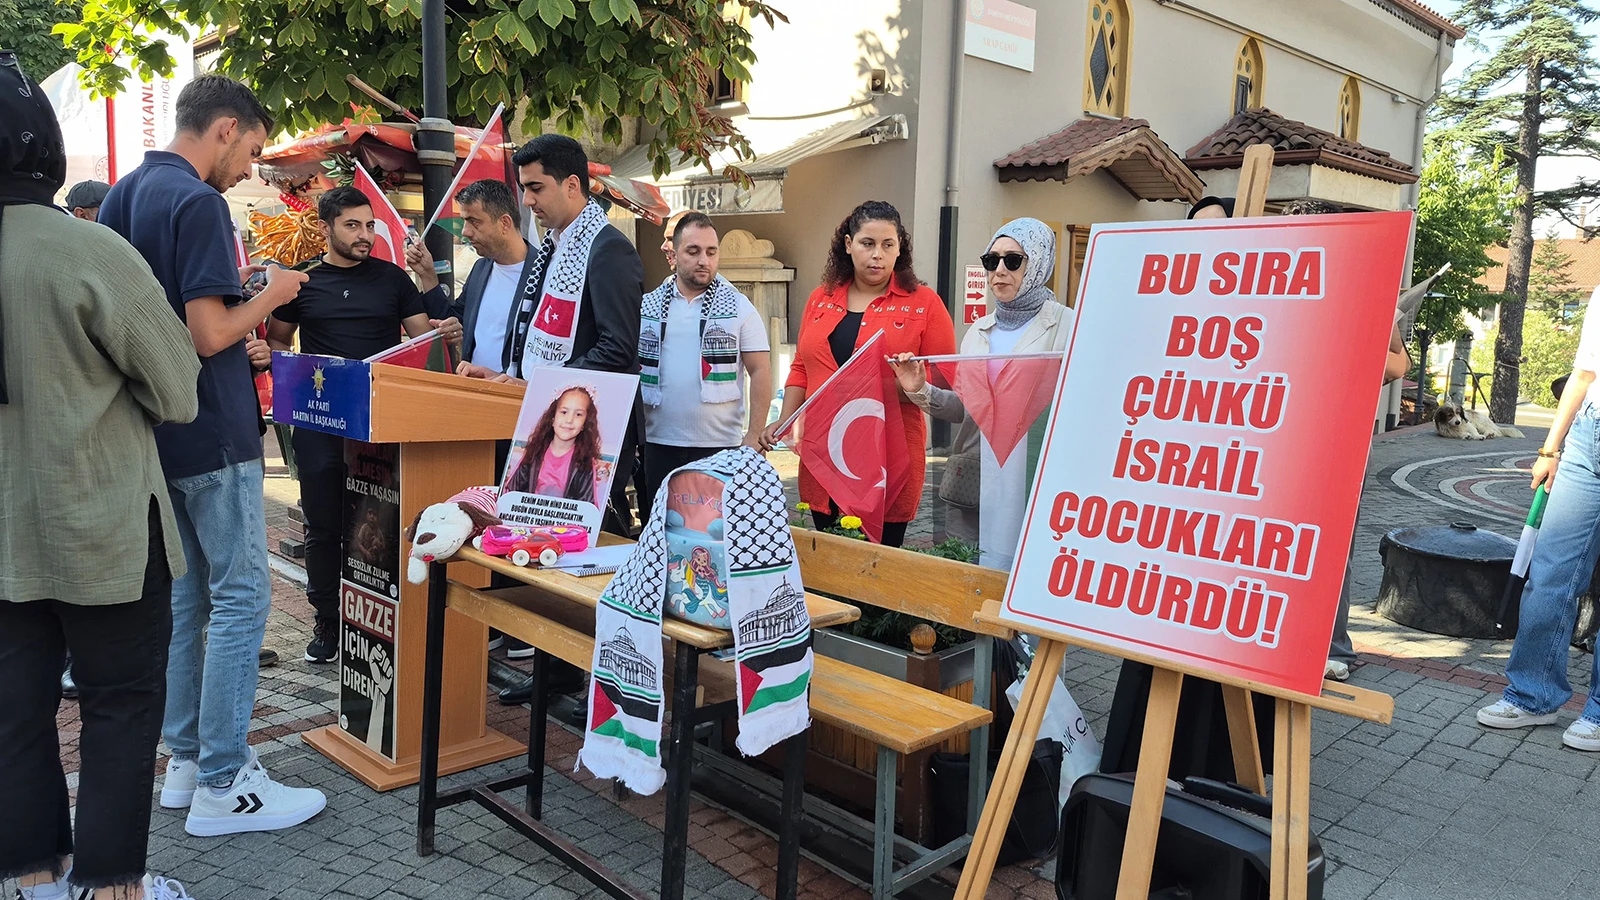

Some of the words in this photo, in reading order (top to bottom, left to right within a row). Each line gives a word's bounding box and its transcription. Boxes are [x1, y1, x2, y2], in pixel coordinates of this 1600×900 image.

[142, 83, 156, 148] BAKANL
[1137, 253, 1202, 295] BU
[1208, 251, 1321, 296] SIRA
[1165, 315, 1263, 370] BOŞ
[307, 399, 315, 409] AK
[315, 401, 330, 412] PARTİ
[1122, 370, 1286, 430] ÇÜNKÜ
[292, 410, 310, 422] BARTIN
[315, 414, 346, 430] BAŞKANLIĞI
[1112, 429, 1261, 497] İSRAİL
[346, 477, 368, 495] GAZZE
[369, 483, 400, 505] YAŞASIN
[536, 497, 550, 507] ADIM
[498, 512, 515, 521] ANCAK
[514, 515, 531, 525] HENÜZ
[527, 507, 544, 516] OKULA
[1049, 491, 1316, 576] ÇOCUKLARI
[372, 566, 390, 582] ZULME
[345, 590, 393, 638] GAZZE
[1047, 546, 1284, 644] ÖLDÜRDÜ!
[344, 624, 369, 662] İÇİN
[343, 664, 374, 701] DİREN
